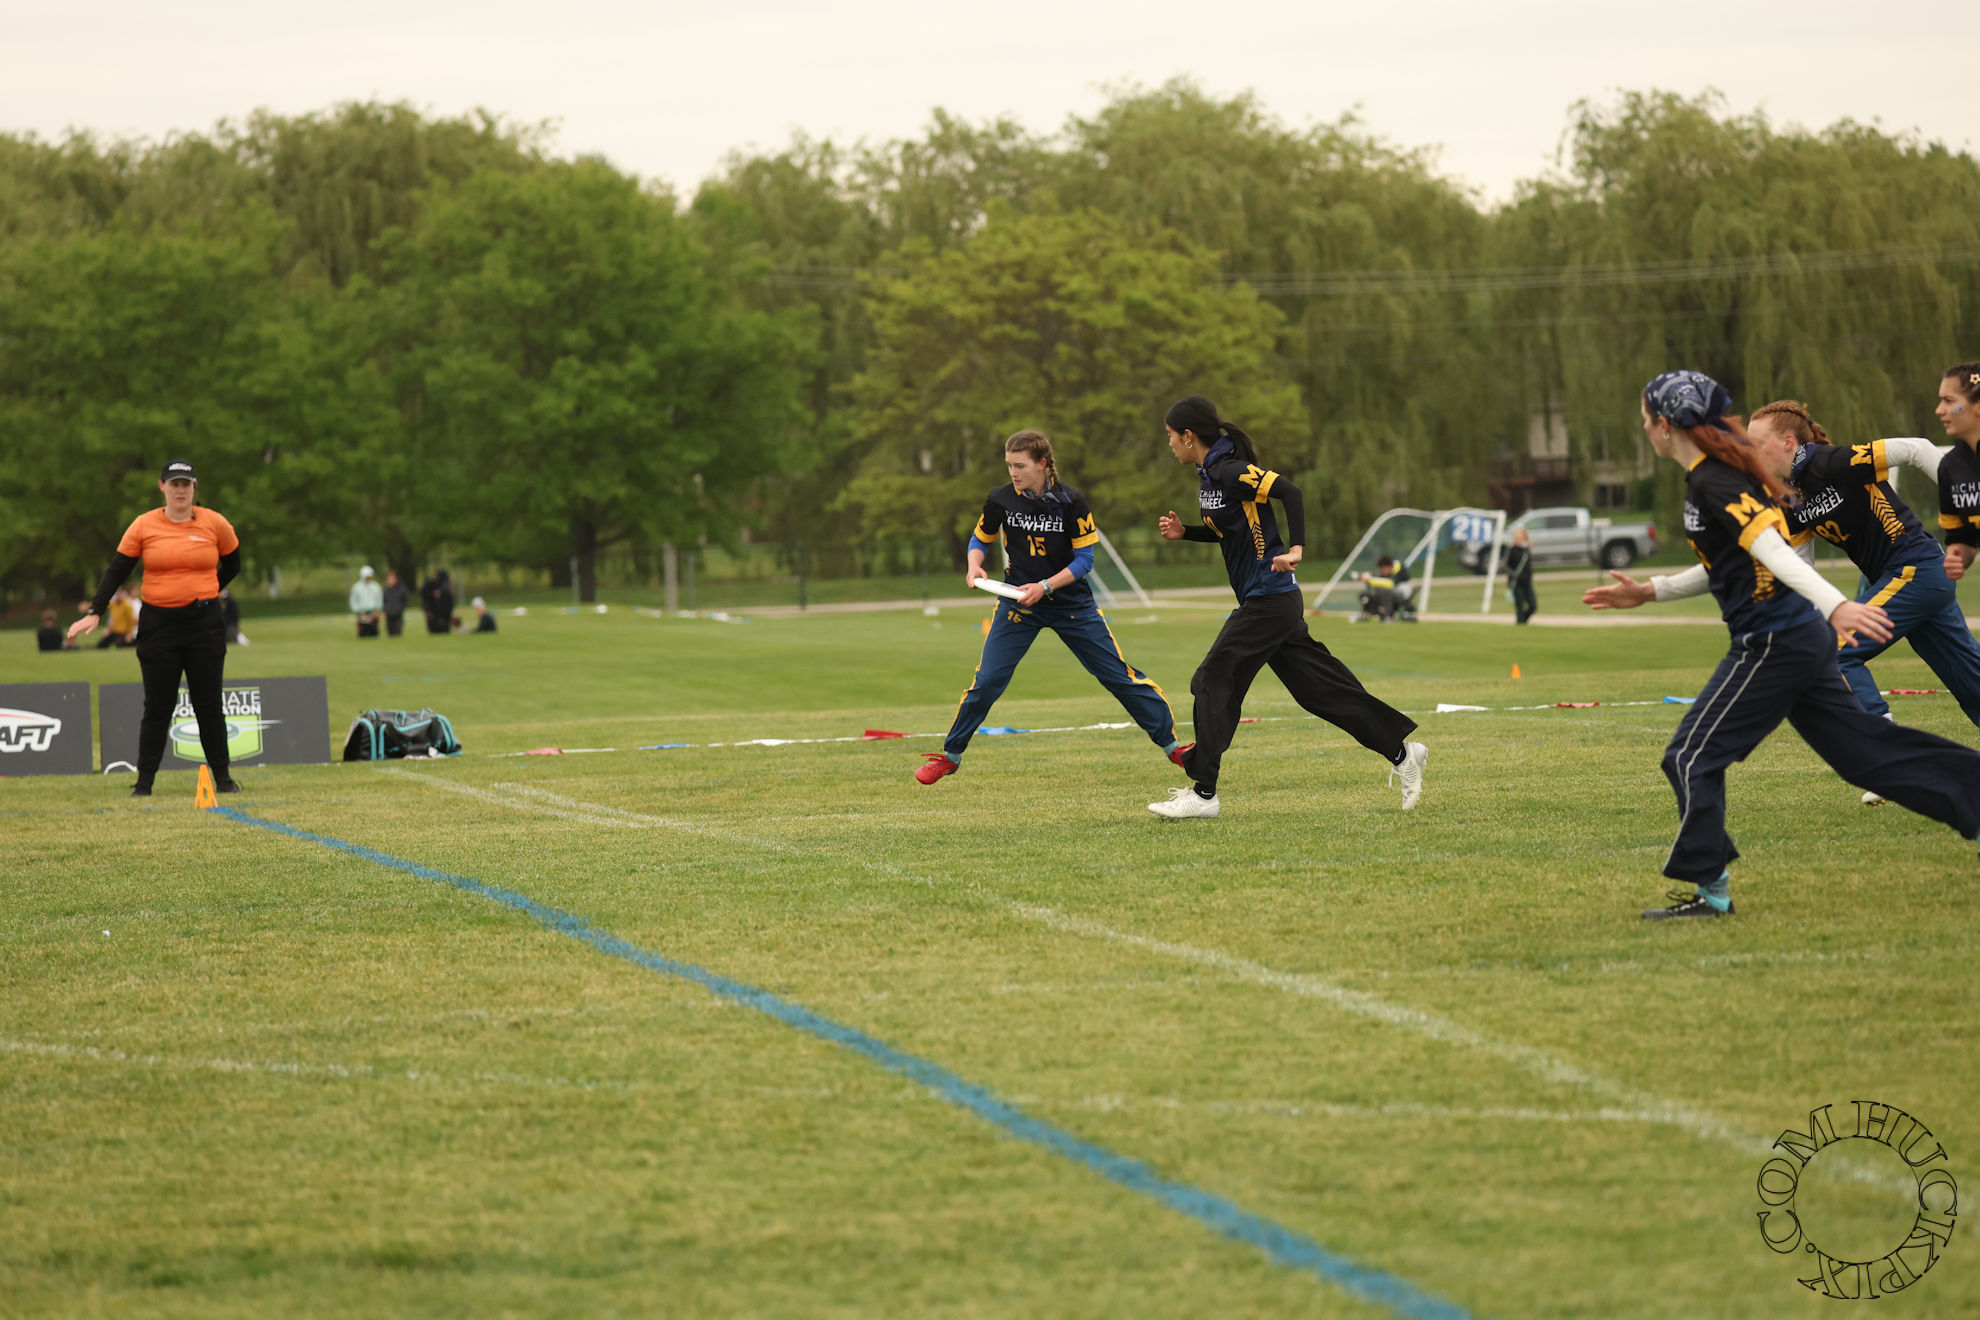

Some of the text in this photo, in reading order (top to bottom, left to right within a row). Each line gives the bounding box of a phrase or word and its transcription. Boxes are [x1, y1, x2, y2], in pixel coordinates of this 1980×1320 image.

[1239, 464, 1266, 489] M
[1725, 492, 1765, 527] M
[1077, 512, 1096, 535] M
[1027, 535, 1047, 556] 15
